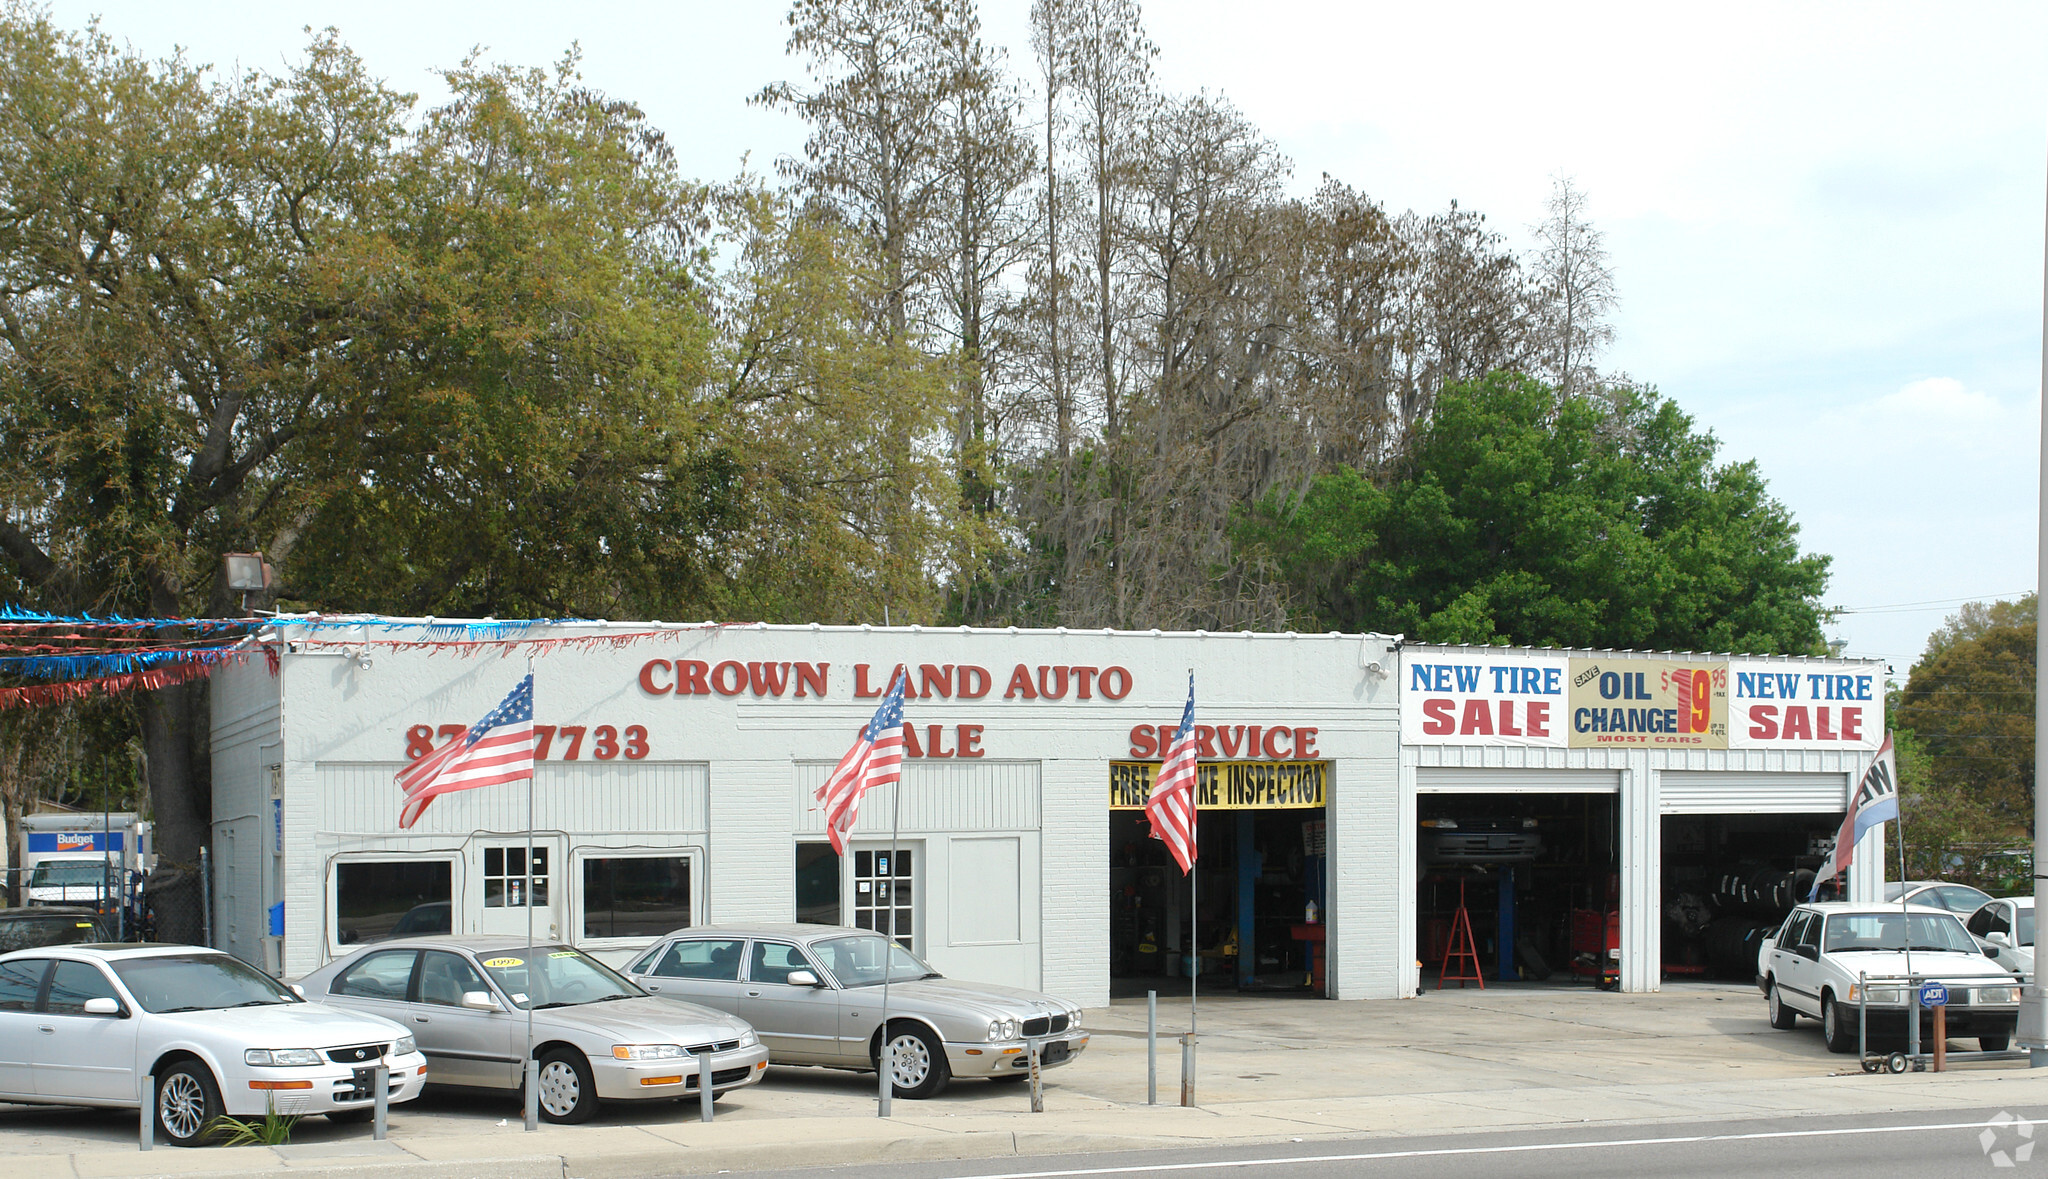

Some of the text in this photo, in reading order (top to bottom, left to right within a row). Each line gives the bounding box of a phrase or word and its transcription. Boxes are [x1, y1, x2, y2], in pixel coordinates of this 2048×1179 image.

[639, 659, 1133, 700] CROWN LAND AUTO
[1411, 664, 1562, 695] NEW TIRE
[1574, 666, 1600, 687] SAVE
[1599, 671, 1652, 700] OIL
[1736, 672, 1872, 700] NEW TIRE
[1423, 699, 1550, 737] SALE
[1574, 707, 1677, 733] CHANGE
[1749, 705, 1862, 741] SALE
[859, 722, 985, 757] ALE
[1111, 765, 1150, 805] FREE
[57, 834, 94, 845] Budget
[1924, 989, 1943, 999] ADT
